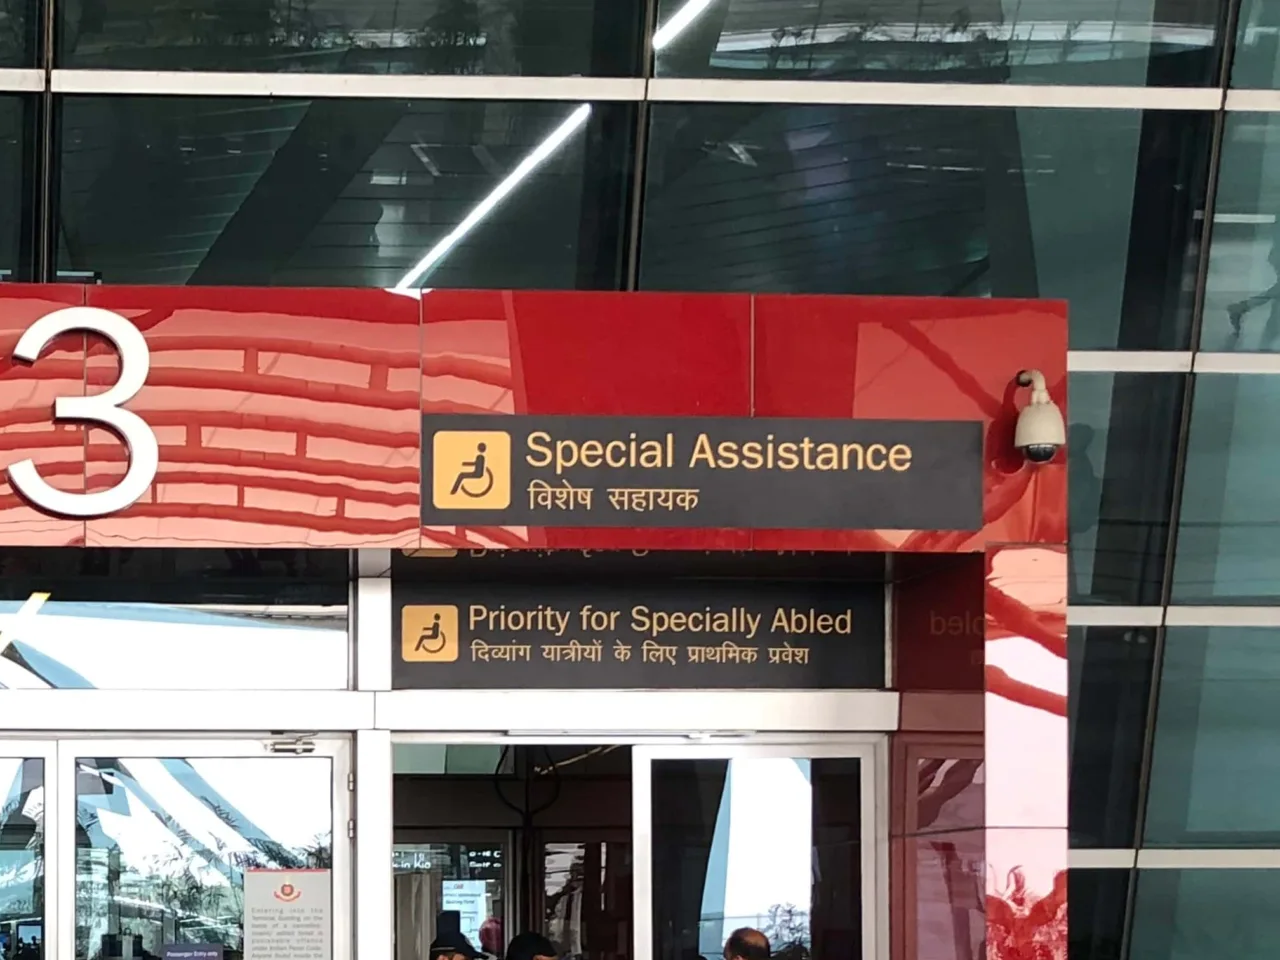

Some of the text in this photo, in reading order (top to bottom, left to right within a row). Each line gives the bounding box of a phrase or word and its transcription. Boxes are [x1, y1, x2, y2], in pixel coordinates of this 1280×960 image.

[8, 306, 158, 518] 3
[525, 431, 913, 475] Special Assistance
[527, 478, 700, 512] विशेष सहायक
[469, 604, 851, 639] Priority for Specially Abled
[470, 638, 531, 663] दिव्यांग
[613, 639, 631, 662] के
[641, 639, 678, 666] लिए
[687, 639, 758, 664] प्राथमिक
[768, 641, 810, 664] प्रवेश
